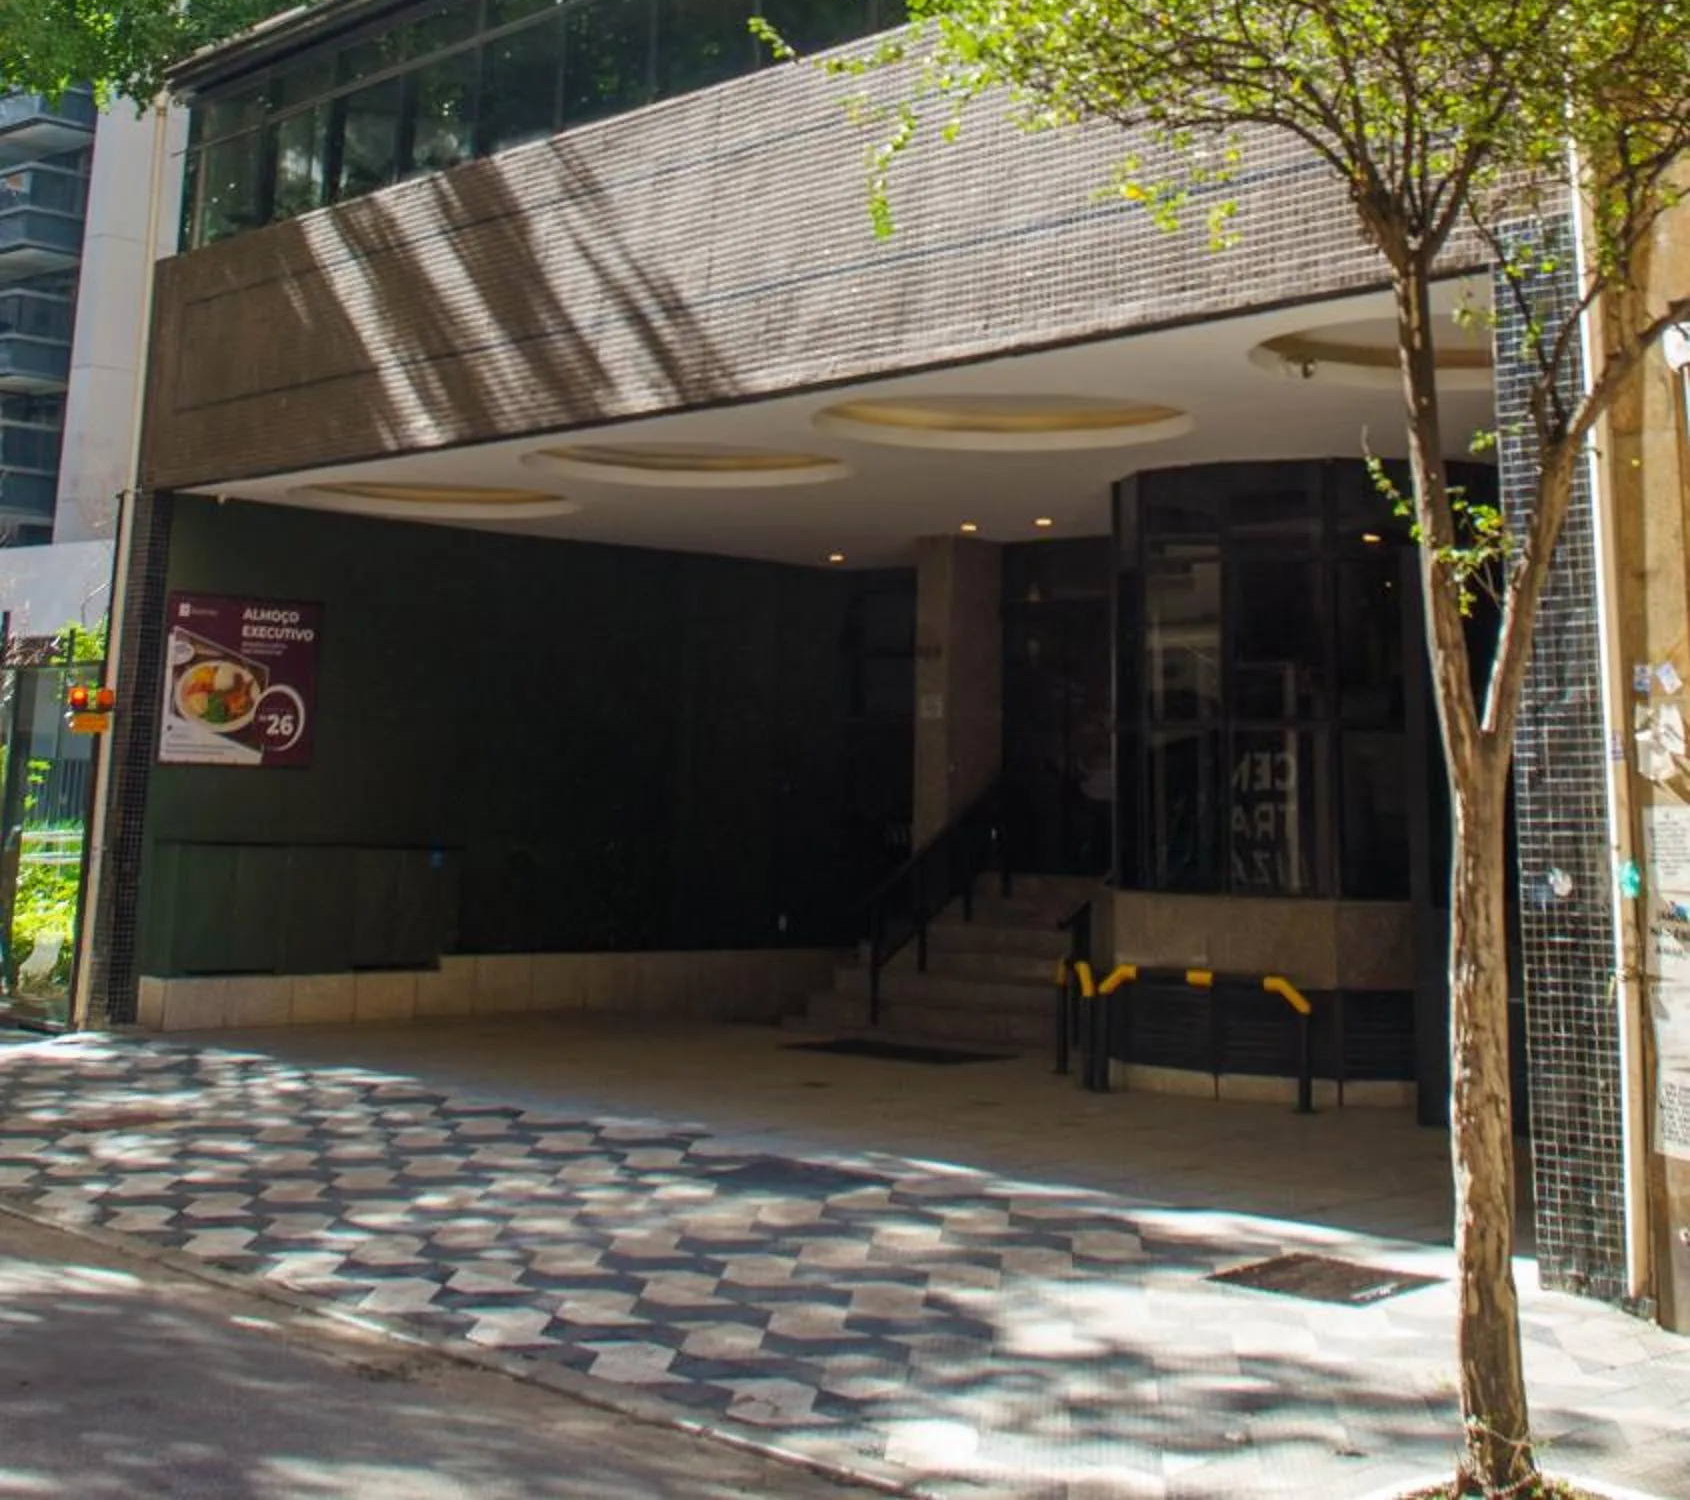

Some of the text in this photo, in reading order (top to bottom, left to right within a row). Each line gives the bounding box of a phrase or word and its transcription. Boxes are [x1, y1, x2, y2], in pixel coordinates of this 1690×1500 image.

[243, 608, 300, 625] ALMOÇO
[242, 625, 315, 642] EXECUTIVO
[266, 713, 294, 736] 26
